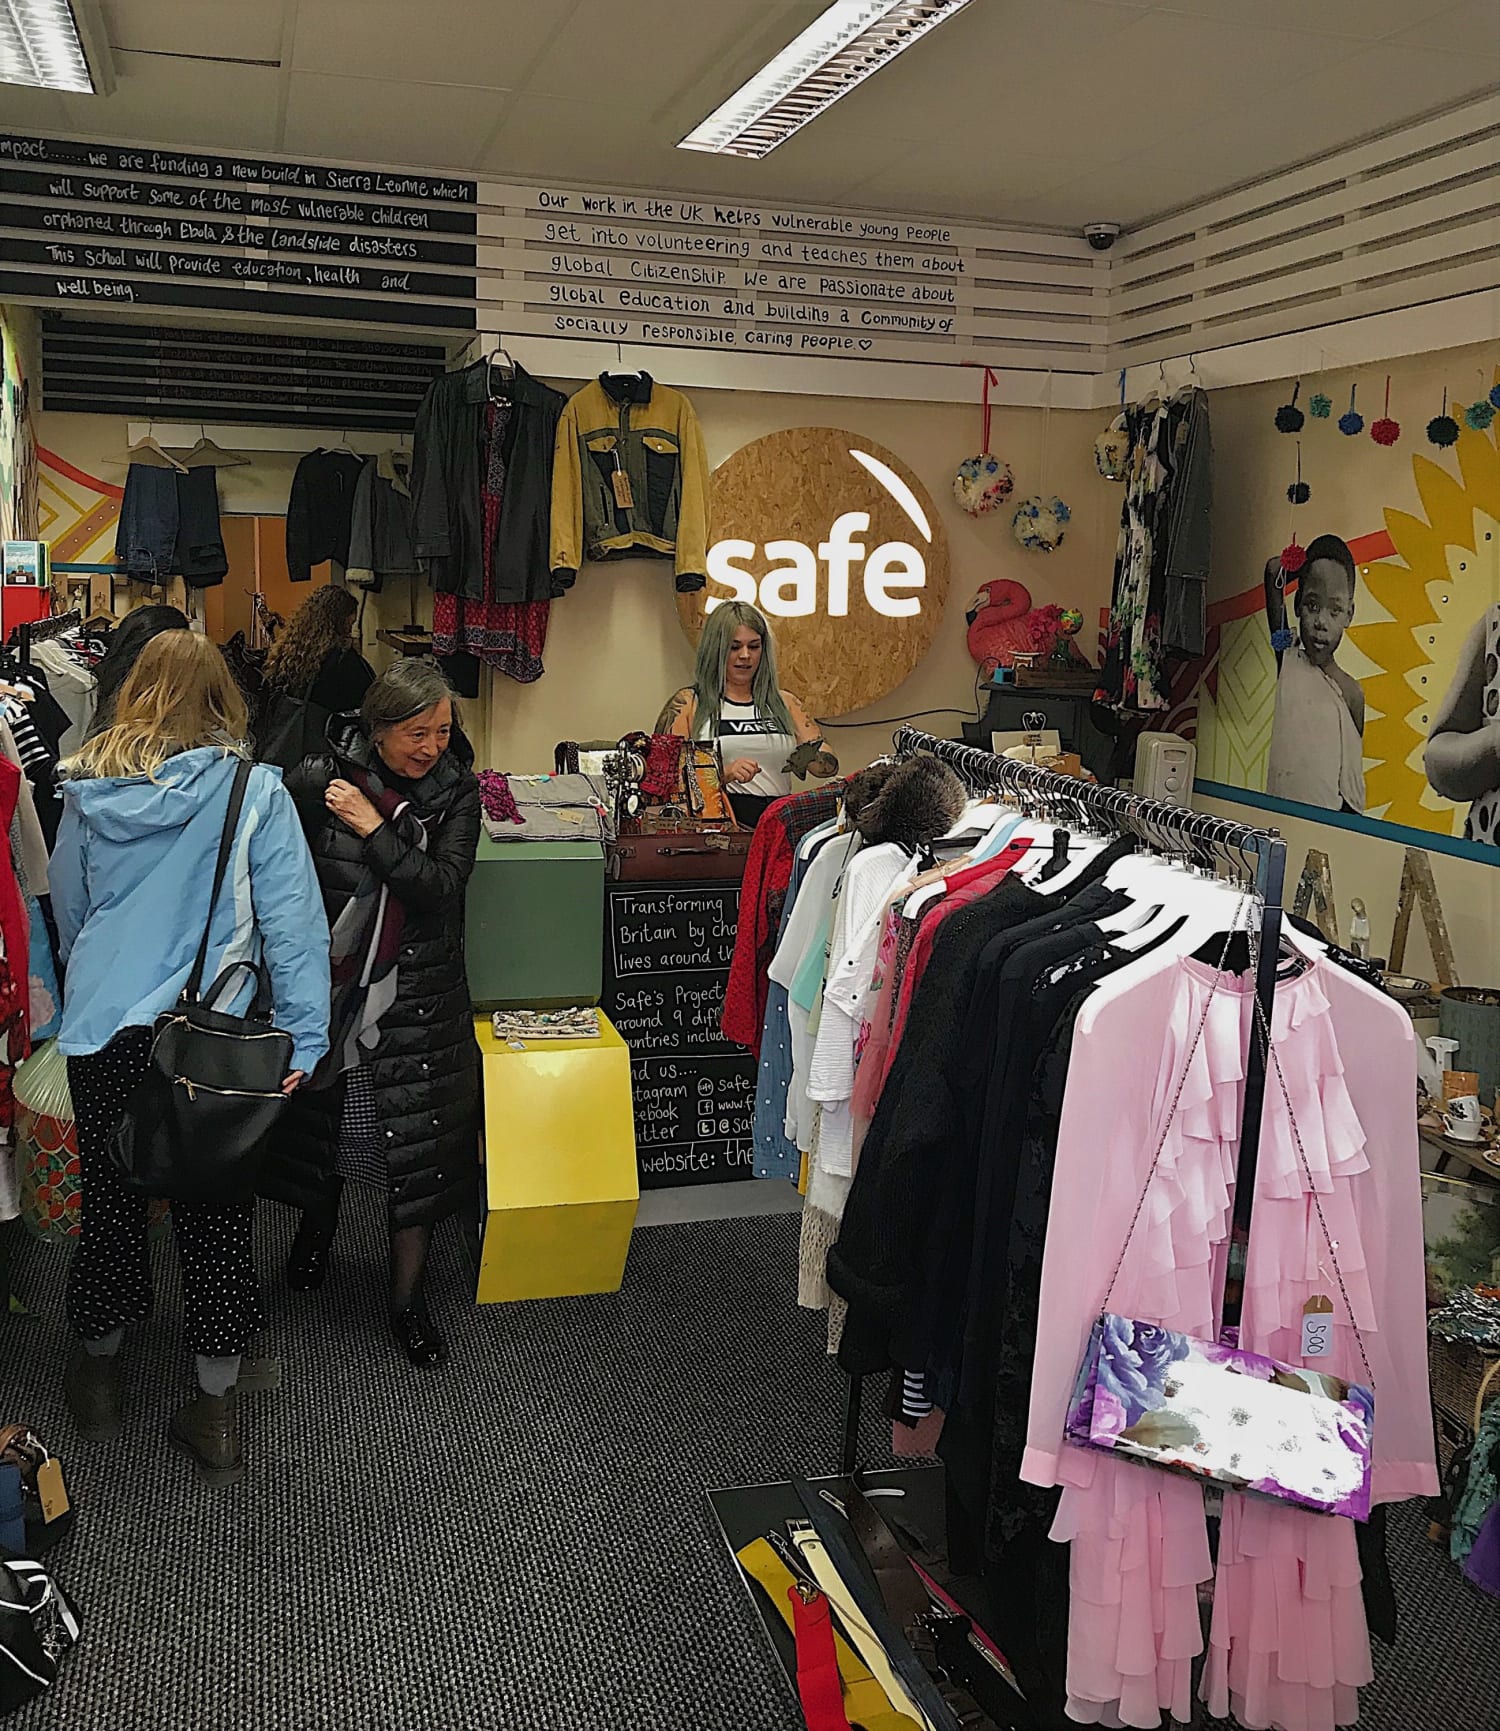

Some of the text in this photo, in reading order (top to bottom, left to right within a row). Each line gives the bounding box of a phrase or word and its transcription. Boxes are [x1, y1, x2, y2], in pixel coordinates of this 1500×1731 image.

[119, 154, 144, 169] are
[151, 152, 209, 178] funding
[214, 161, 224, 177] a
[232, 164, 257, 179] new
[261, 166, 300, 184] build
[305, 170, 317, 186] in
[325, 171, 371, 191] Sierra
[433, 183, 468, 200] which
[50, 179, 74, 196] will
[190, 190, 207, 208] of
[213, 192, 242, 211] the
[251, 198, 291, 216] most
[299, 203, 365, 222] vulnerable
[539, 191, 569, 208] Our
[623, 199, 637, 214] in
[644, 201, 673, 218] the
[680, 206, 704, 222] UK
[714, 206, 761, 225] helps
[772, 214, 853, 233] vulnerable
[859, 223, 899, 241] young
[43, 211, 114, 233] orphaned
[120, 217, 172, 240] through
[180, 222, 218, 241] Ebola
[237, 226, 265, 245] the
[545, 223, 965, 273] get into volunteering and teaches them about
[45, 245, 75, 263] This
[135, 252, 163, 271] will
[314, 265, 361, 285] health
[381, 273, 411, 291] and
[551, 256, 613, 277] global
[744, 271, 768, 286] We
[778, 275, 807, 290] are
[820, 278, 905, 300] passionate
[912, 285, 955, 302] about
[550, 285, 605, 305] global
[619, 290, 709, 313] education
[723, 299, 756, 316] and
[765, 302, 829, 323] building
[840, 309, 850, 324] a
[938, 319, 953, 332] of
[555, 316, 628, 335] socially
[704, 511, 926, 618] safe
[616, 894, 723, 923] Transforming
[620, 920, 737, 948] Britain by cha
[620, 945, 735, 970] lives around th
[615, 980, 728, 1011] Safe's Project
[615, 1007, 721, 1031] around 9 diff
[717, 1093, 756, 1112] www.f
[641, 1139, 755, 1173] website: the
